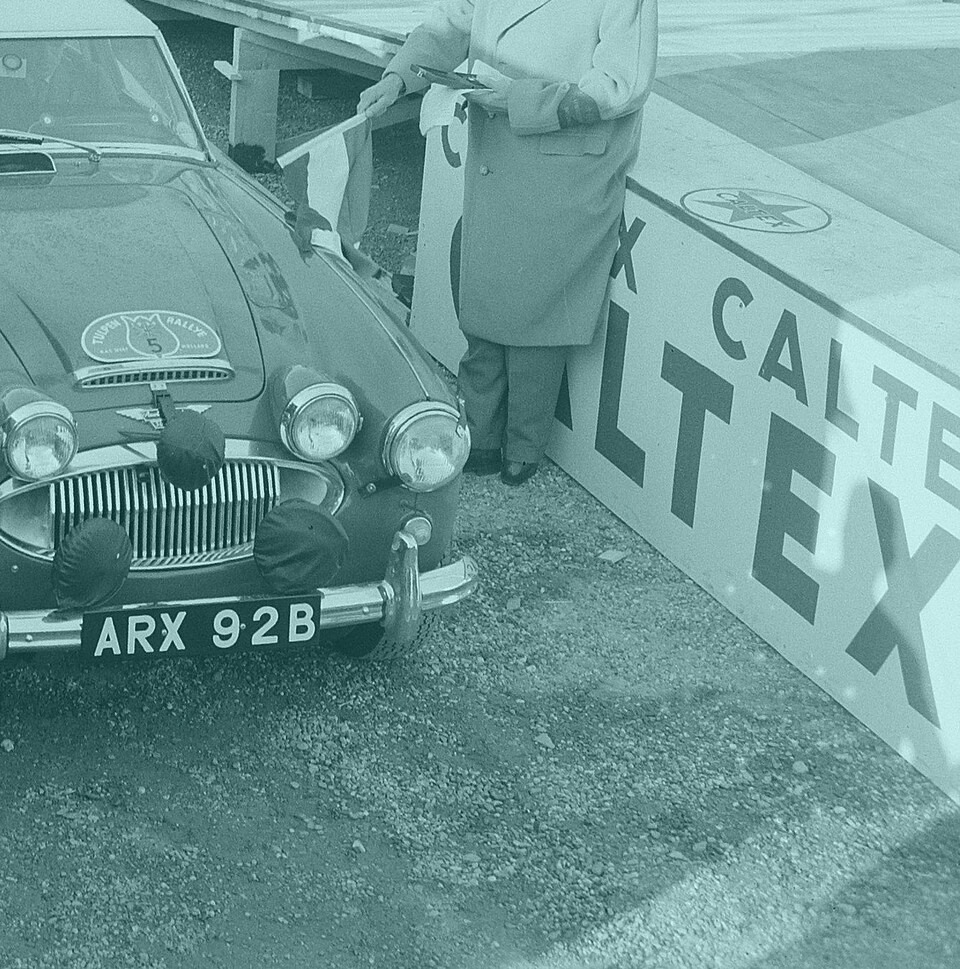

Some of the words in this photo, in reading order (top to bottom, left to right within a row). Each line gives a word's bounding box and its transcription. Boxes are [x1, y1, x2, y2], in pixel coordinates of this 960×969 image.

[92, 319, 121, 345] TULPEN
[166, 316, 208, 338] RALLYE
[146, 338, 163, 353] 5
[450, 216, 960, 731] LTEX
[93, 611, 188, 657] ARX
[211, 602, 317, 650] 92B
